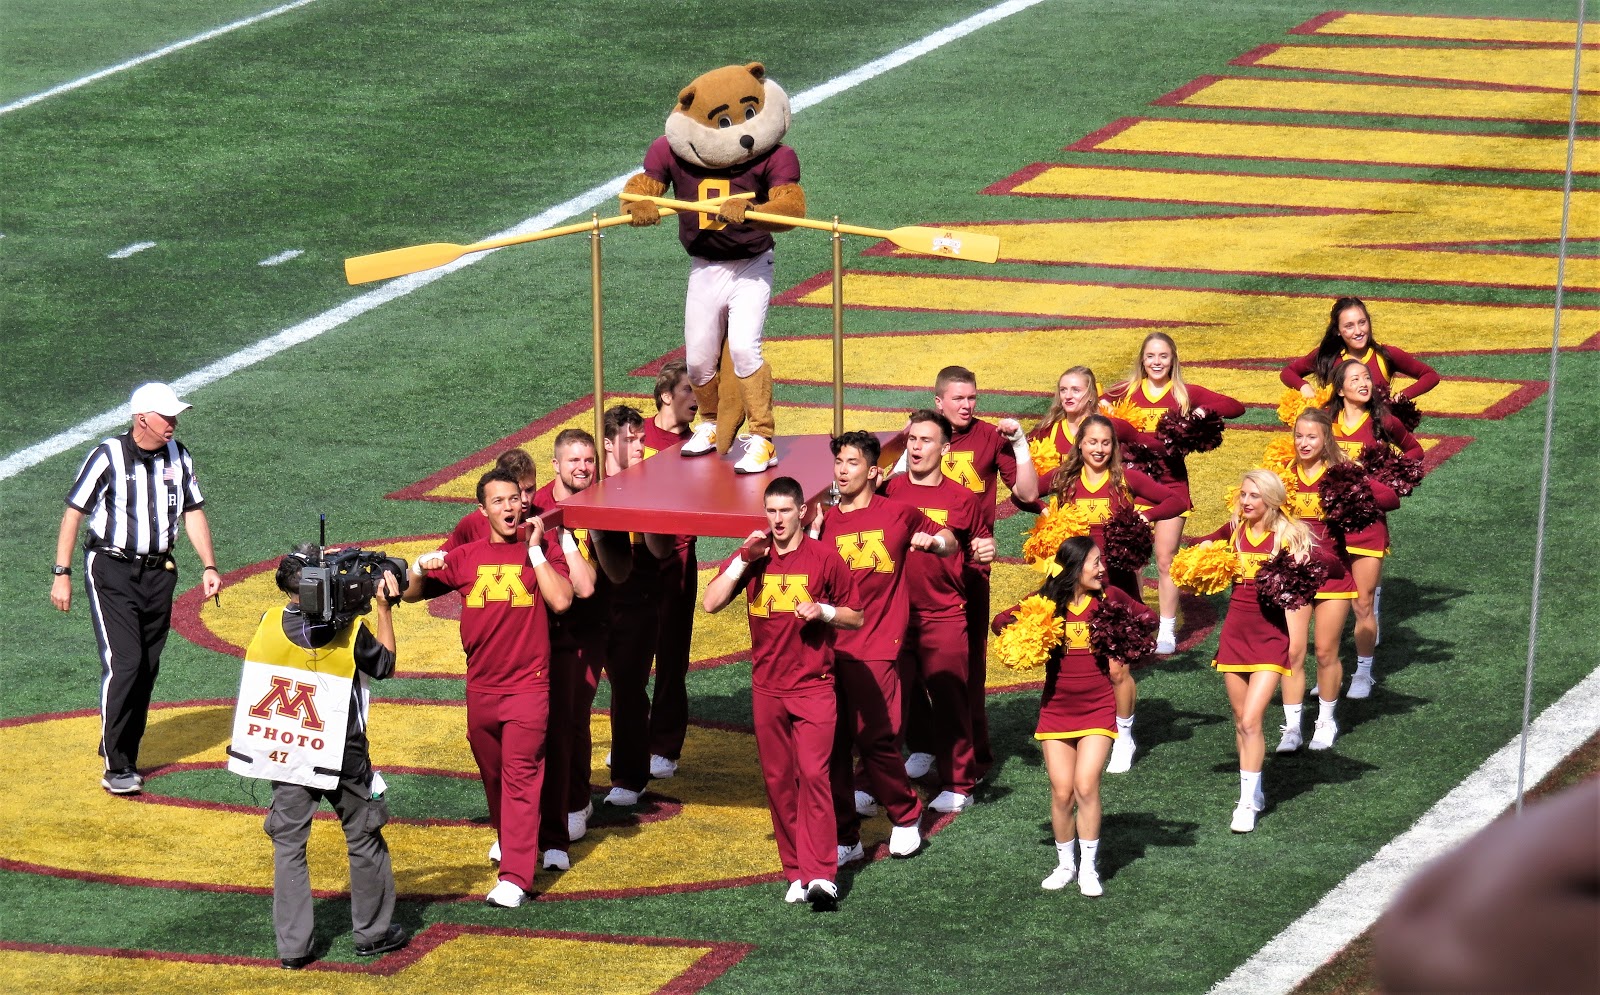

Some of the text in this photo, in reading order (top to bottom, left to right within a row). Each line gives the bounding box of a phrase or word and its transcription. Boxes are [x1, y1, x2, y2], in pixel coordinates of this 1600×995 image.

[168, 493, 178, 506] R
[835, 529, 896, 574] M
[466, 564, 535, 608] M
[749, 573, 815, 619] M
[248, 675, 326, 732] M
[247, 723, 325, 750] PHOTO
[268, 750, 289, 764] 47
